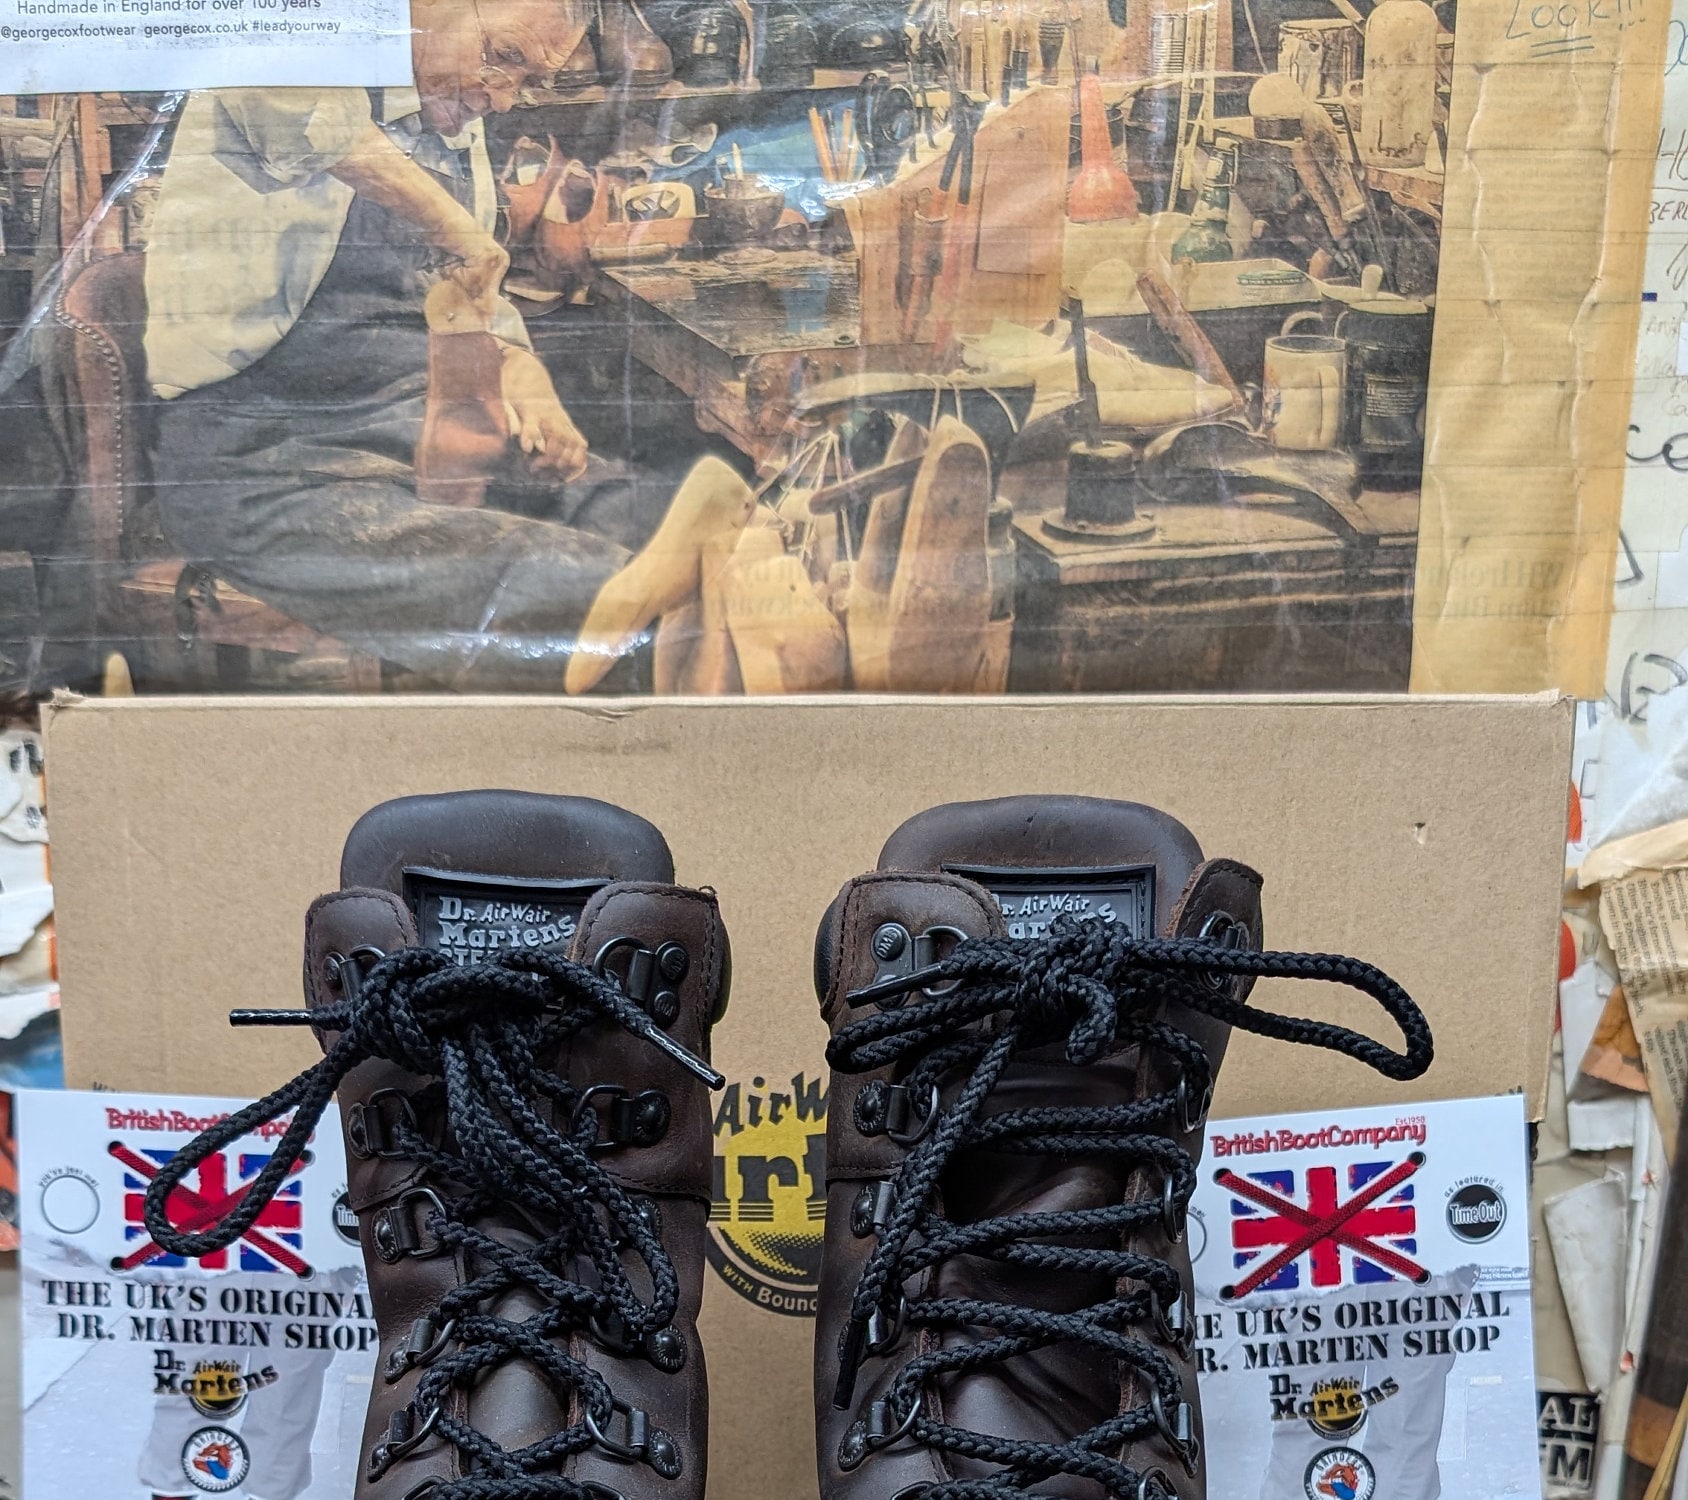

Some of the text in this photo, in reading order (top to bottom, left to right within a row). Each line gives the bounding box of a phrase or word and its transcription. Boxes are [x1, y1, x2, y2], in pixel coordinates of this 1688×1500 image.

[17, 0, 321, 15] Handmade in England for over 100 years
[1, 19, 341, 41] @georgecoxfootwear georgecox.co.uk #leadyourway
[438, 895, 552, 923] Dr. AirWair
[1019, 893, 1091, 915] AirWair
[439, 914, 577, 948] Martens
[1210, 1123, 1426, 1157] BritishBootCompany
[335, 1203, 360, 1226] Tim
[42, 1280, 374, 1318] THE UK'S ORIGINA
[1236, 1304, 1322, 1337] UK'S
[1334, 1290, 1510, 1330] ORIGINAL
[58, 1313, 379, 1351] DR. MARTEN SHOP
[1242, 1333, 1389, 1370] MARTEN
[1403, 1325, 1500, 1357] SHOP
[154, 1364, 280, 1395] Martens
[1270, 1376, 1400, 1420] Martens
